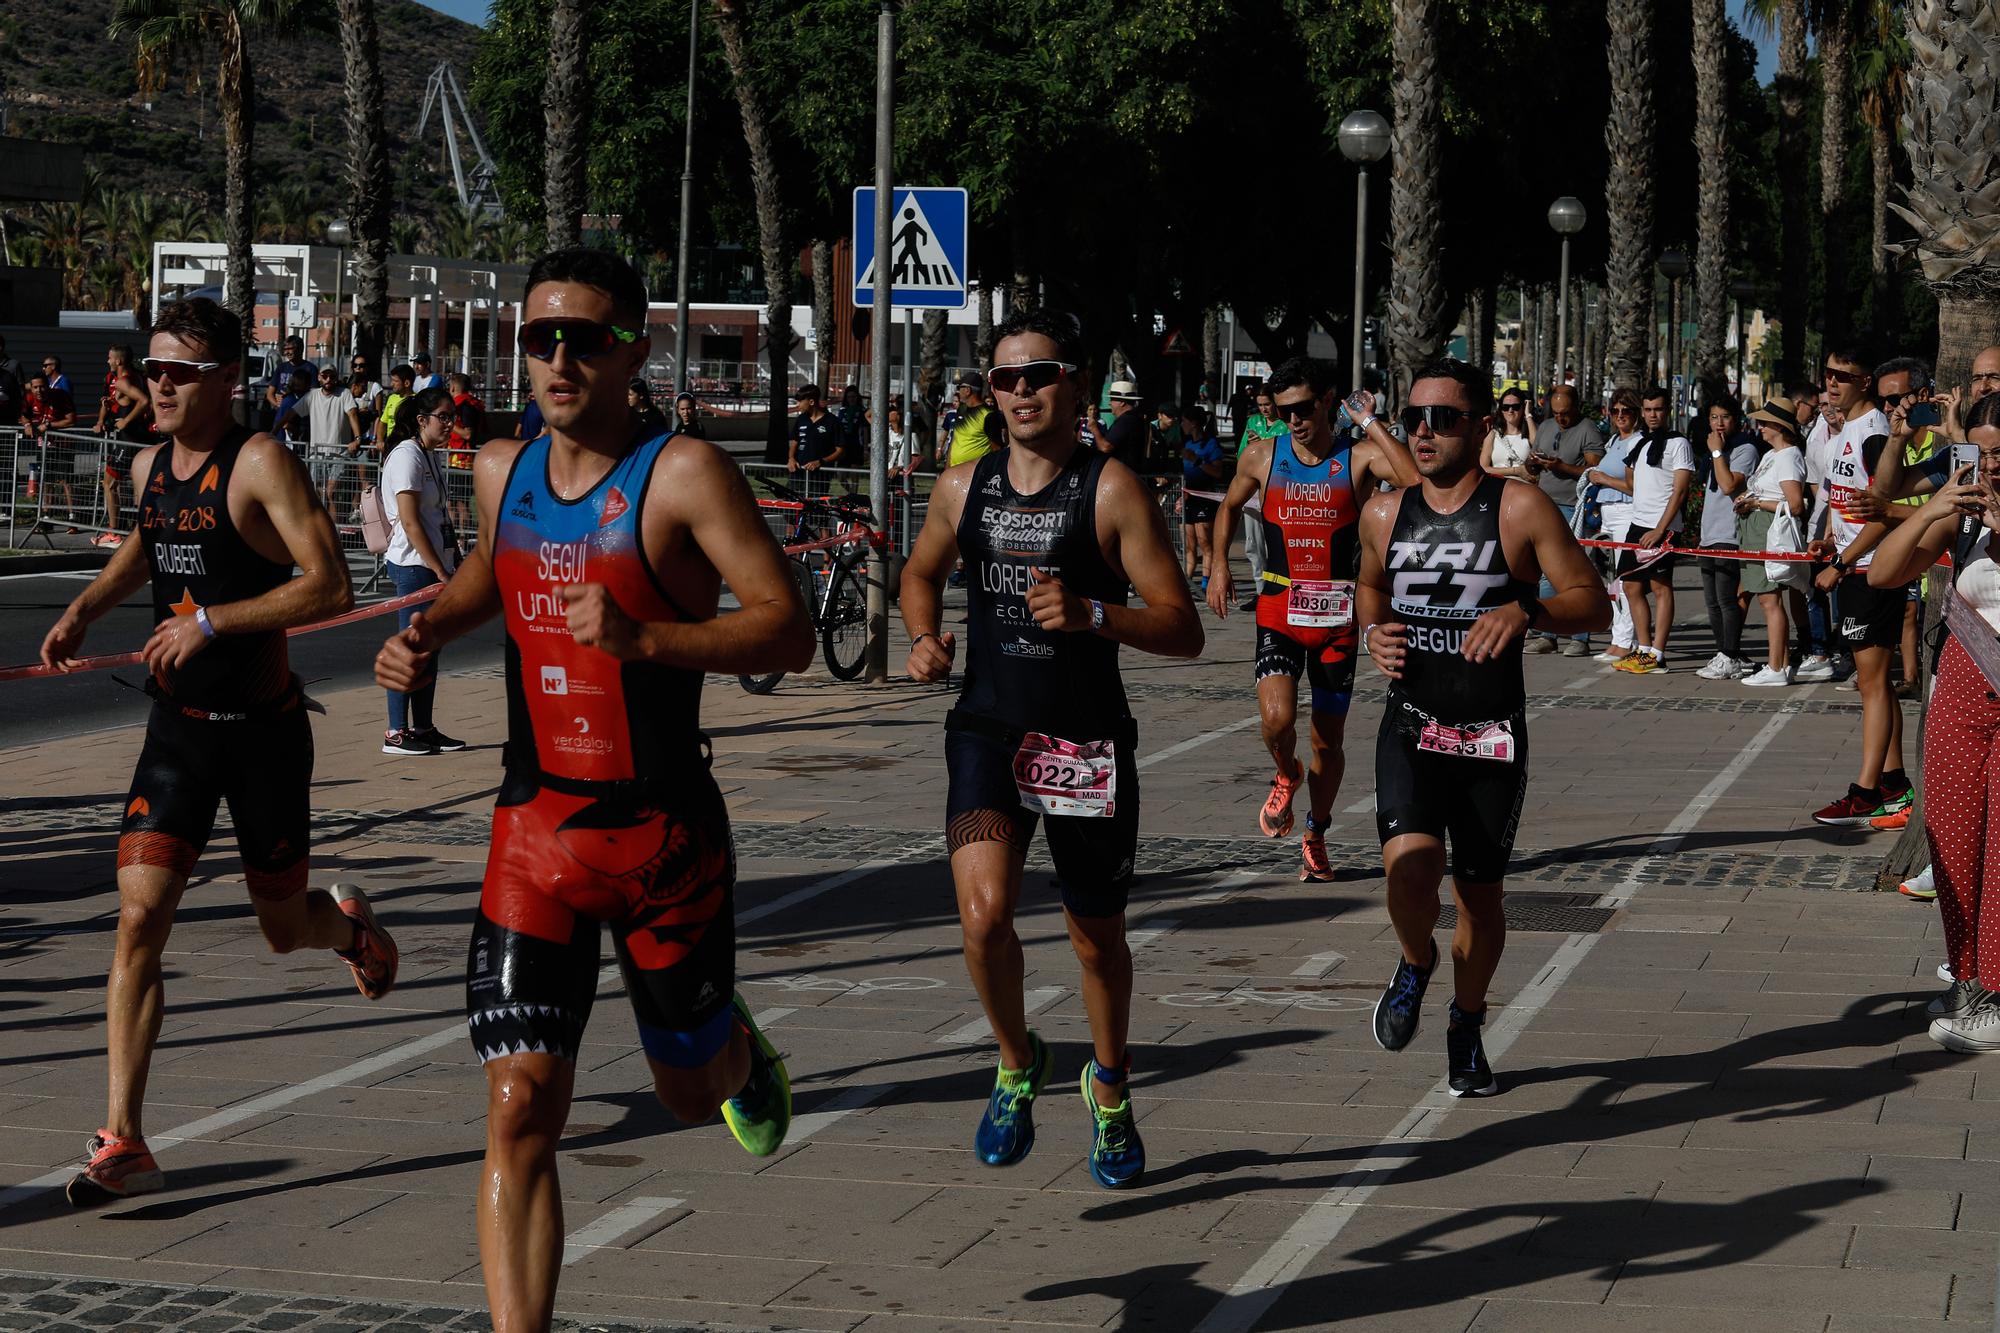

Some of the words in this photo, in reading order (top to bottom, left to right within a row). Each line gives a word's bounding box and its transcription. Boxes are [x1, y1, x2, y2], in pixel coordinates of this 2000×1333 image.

[1285, 481, 1331, 503] MORENO
[177, 507, 217, 532] 208
[981, 506, 1067, 528] ECOSPORT
[1278, 504, 1337, 520] UniData
[1287, 538, 1325, 548] BNFIX
[155, 542, 206, 576] RUBERT
[538, 534, 589, 583] SEGUÍ
[1389, 540, 1497, 571] TRI
[981, 561, 1061, 597] LOREN
[1393, 571, 1511, 608] CT
[1290, 597, 1329, 611] 4030
[1399, 603, 1492, 619] CARTAGEN
[1406, 624, 1471, 655] SEGU
[1082, 791, 1101, 800] MAD
